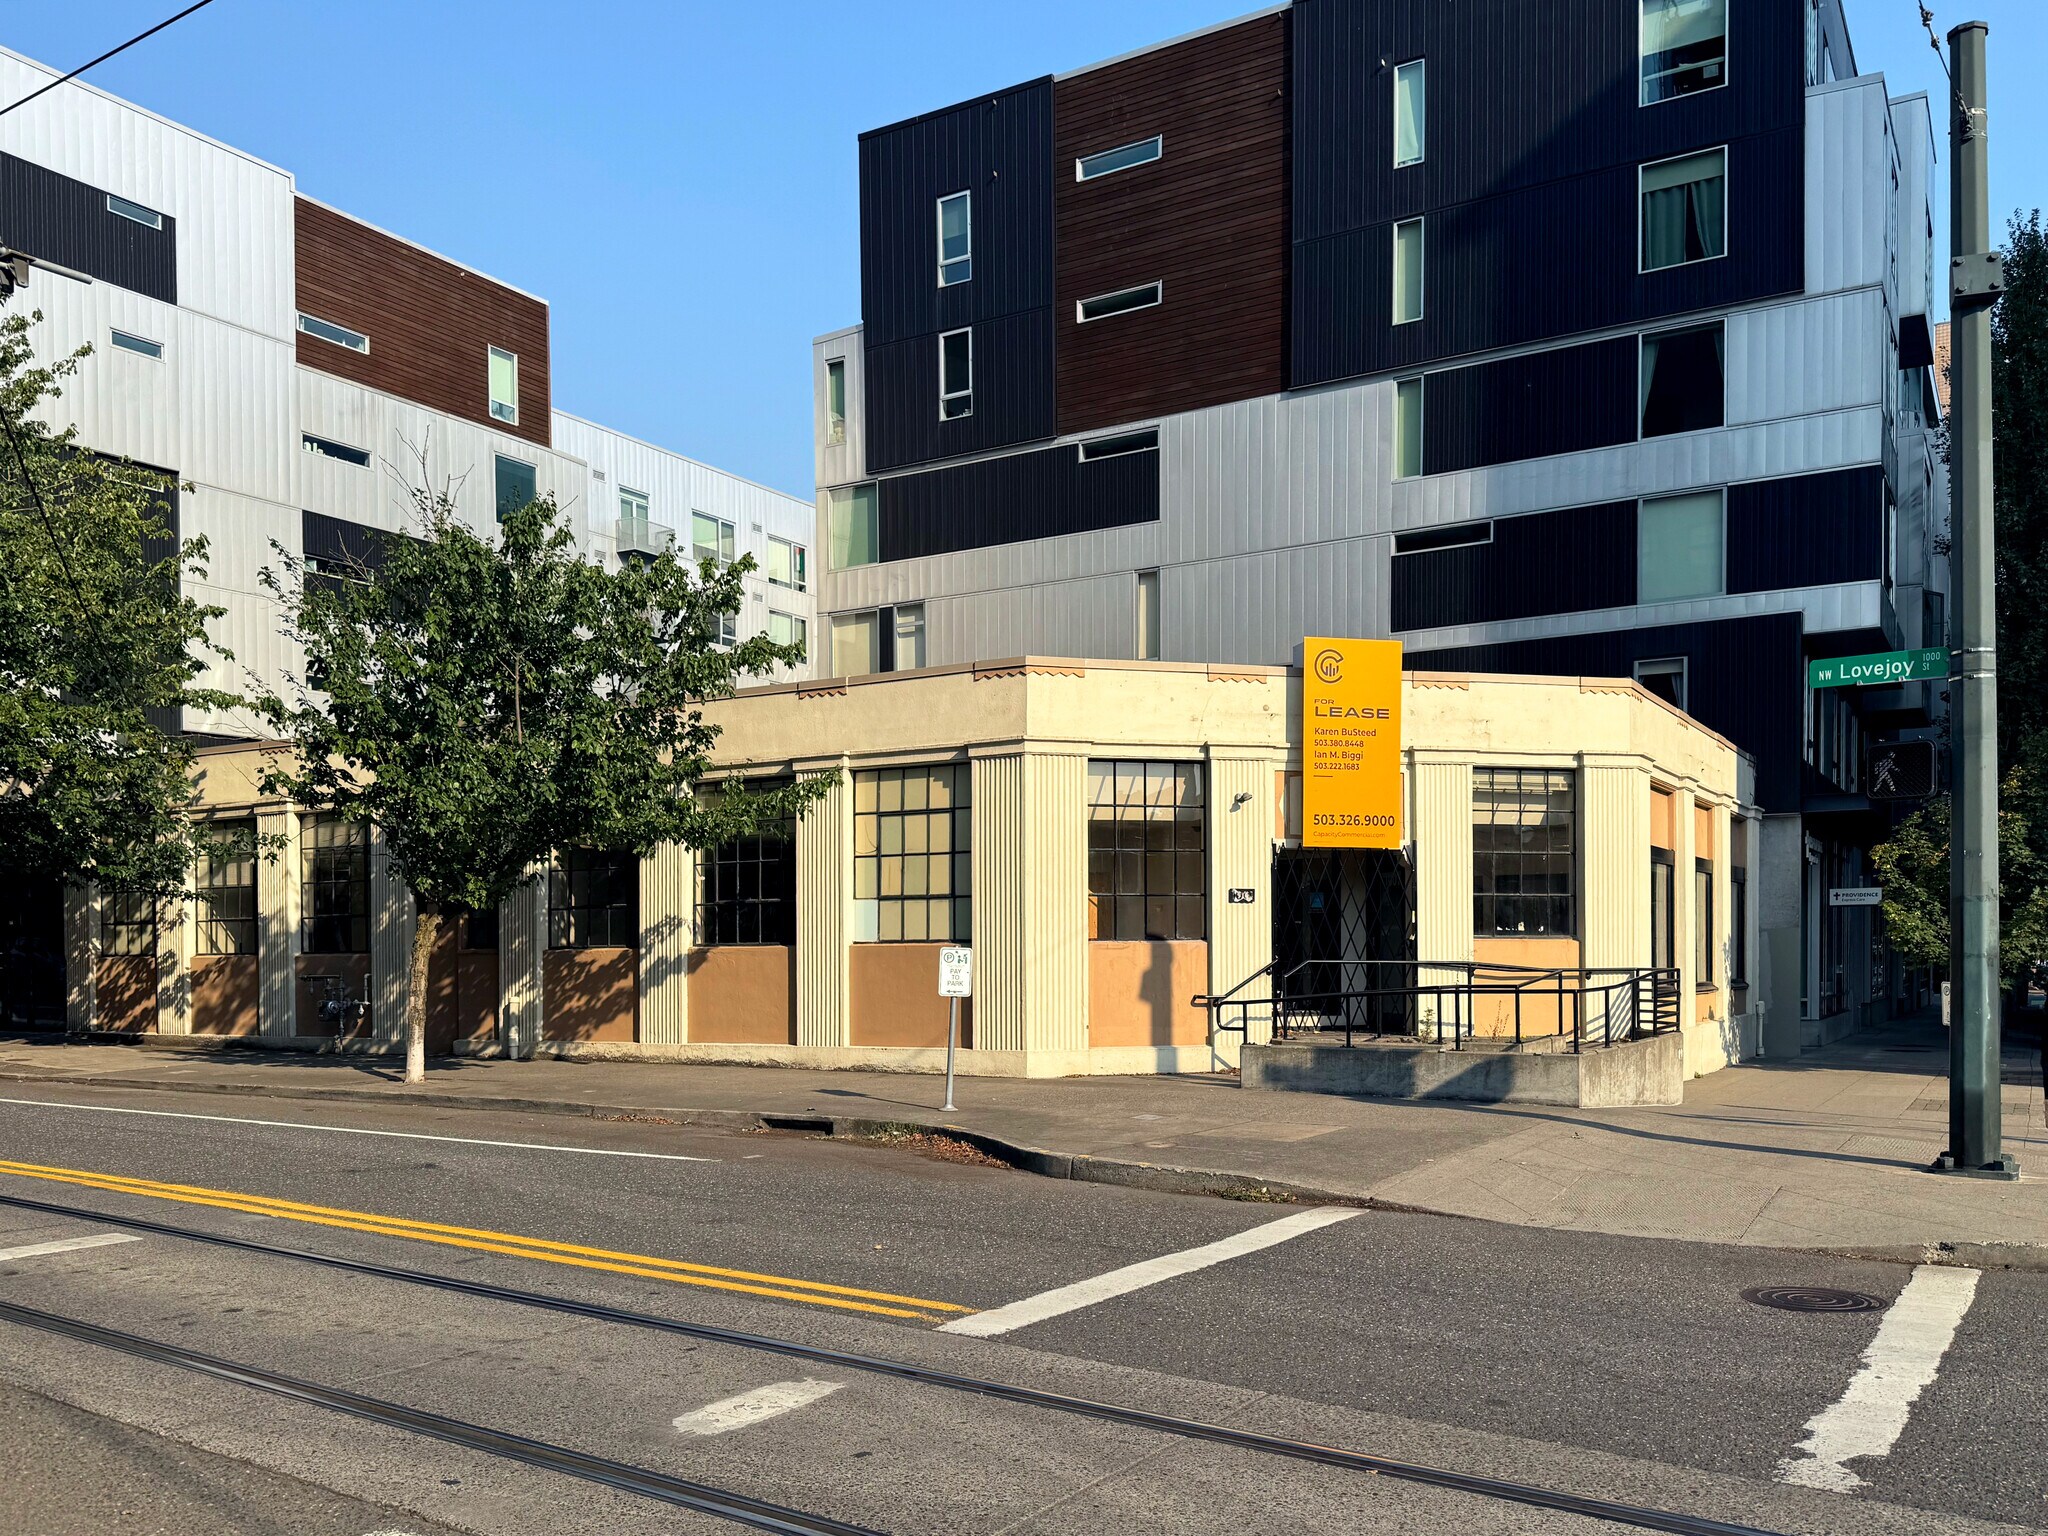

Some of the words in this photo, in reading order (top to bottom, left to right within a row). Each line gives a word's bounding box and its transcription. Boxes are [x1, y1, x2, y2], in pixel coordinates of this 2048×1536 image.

[1922, 651, 1941, 661] 1000
[1818, 670, 1833, 681] NW
[1840, 659, 1915, 680] Lovejoy
[1922, 662, 1930, 671] St
[1315, 706, 1390, 719] LEASE
[1314, 727, 1339, 736] Karen
[1341, 728, 1377, 737] BuSteed
[1314, 739, 1365, 748] 503.380.8448
[1314, 750, 1328, 759] Ian
[1329, 751, 1340, 759] M.
[1341, 751, 1364, 761] Biggi
[1314, 762, 1360, 771] 503.222.1683
[1313, 814, 1395, 827] 503.326.9000
